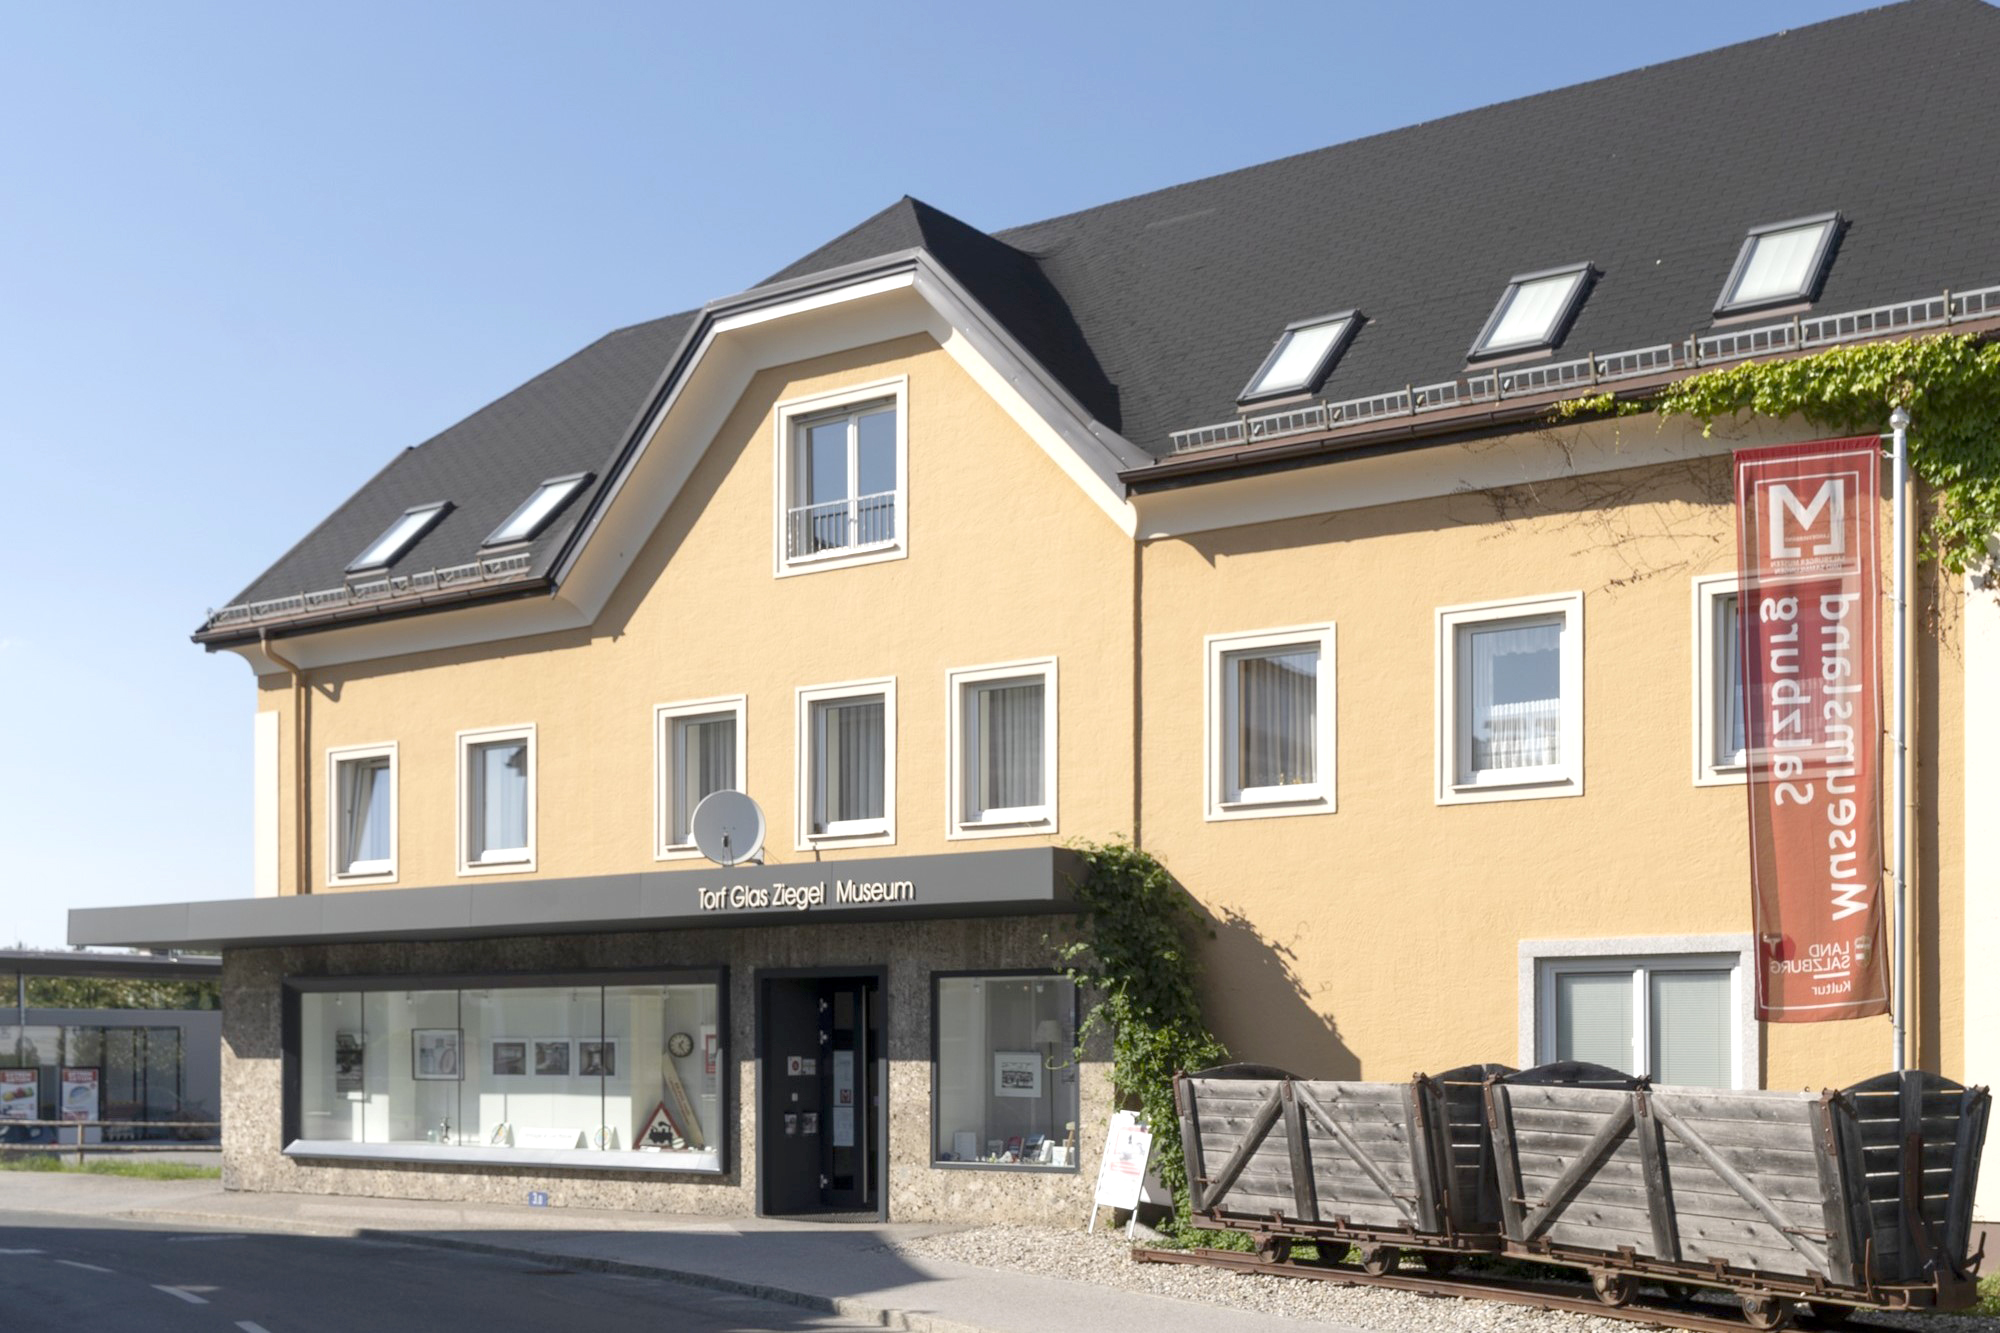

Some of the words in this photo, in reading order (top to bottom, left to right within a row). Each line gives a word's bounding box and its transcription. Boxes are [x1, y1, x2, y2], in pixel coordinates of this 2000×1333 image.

[698, 887, 727, 910] Torf
[730, 885, 769, 908] Glas
[773, 881, 824, 911] Ziegel
[836, 879, 915, 903] Museum
